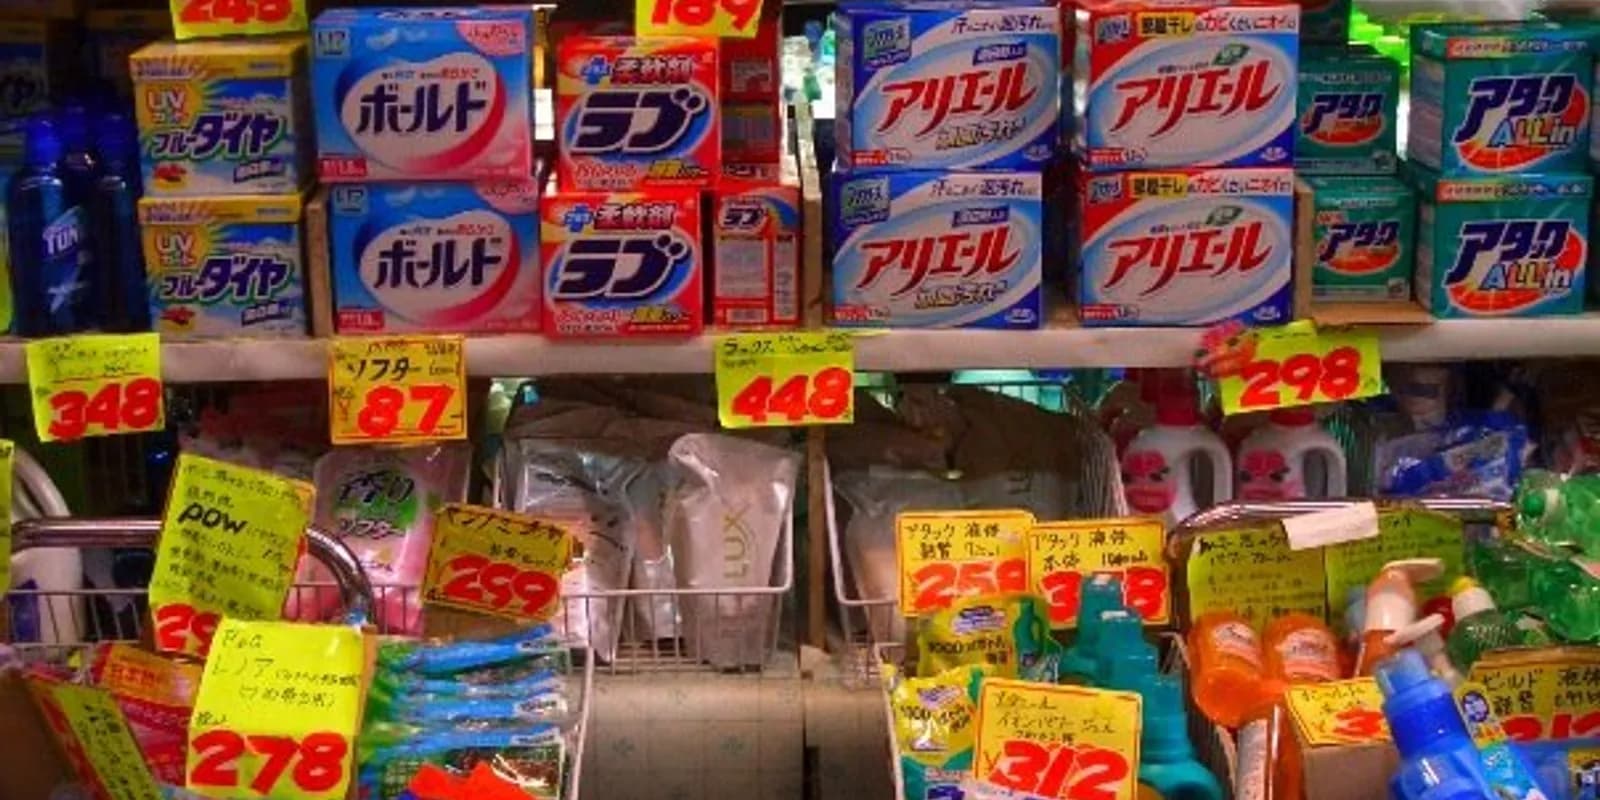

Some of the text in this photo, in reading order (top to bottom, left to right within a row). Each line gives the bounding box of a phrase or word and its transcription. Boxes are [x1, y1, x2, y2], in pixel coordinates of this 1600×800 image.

[356, 82, 487, 134] ボールド
[569, 87, 707, 150] ラブ
[877, 62, 1038, 138] アリエール
[1109, 60, 1281, 138] アリエール
[374, 237, 503, 288] ボールド
[552, 233, 687, 296] ラブ
[857, 226, 1021, 296] アリエール
[1104, 220, 1273, 297] アリエール
[731, 367, 852, 421] 448
[1240, 346, 1362, 406] 298
[48, 376, 161, 440] 348
[358, 383, 454, 436] 87
[725, 509, 748, 578] LUX
[1041, 566, 1167, 623] 38
[191, 729, 347, 797] 278
[989, 739, 1130, 800] 312
